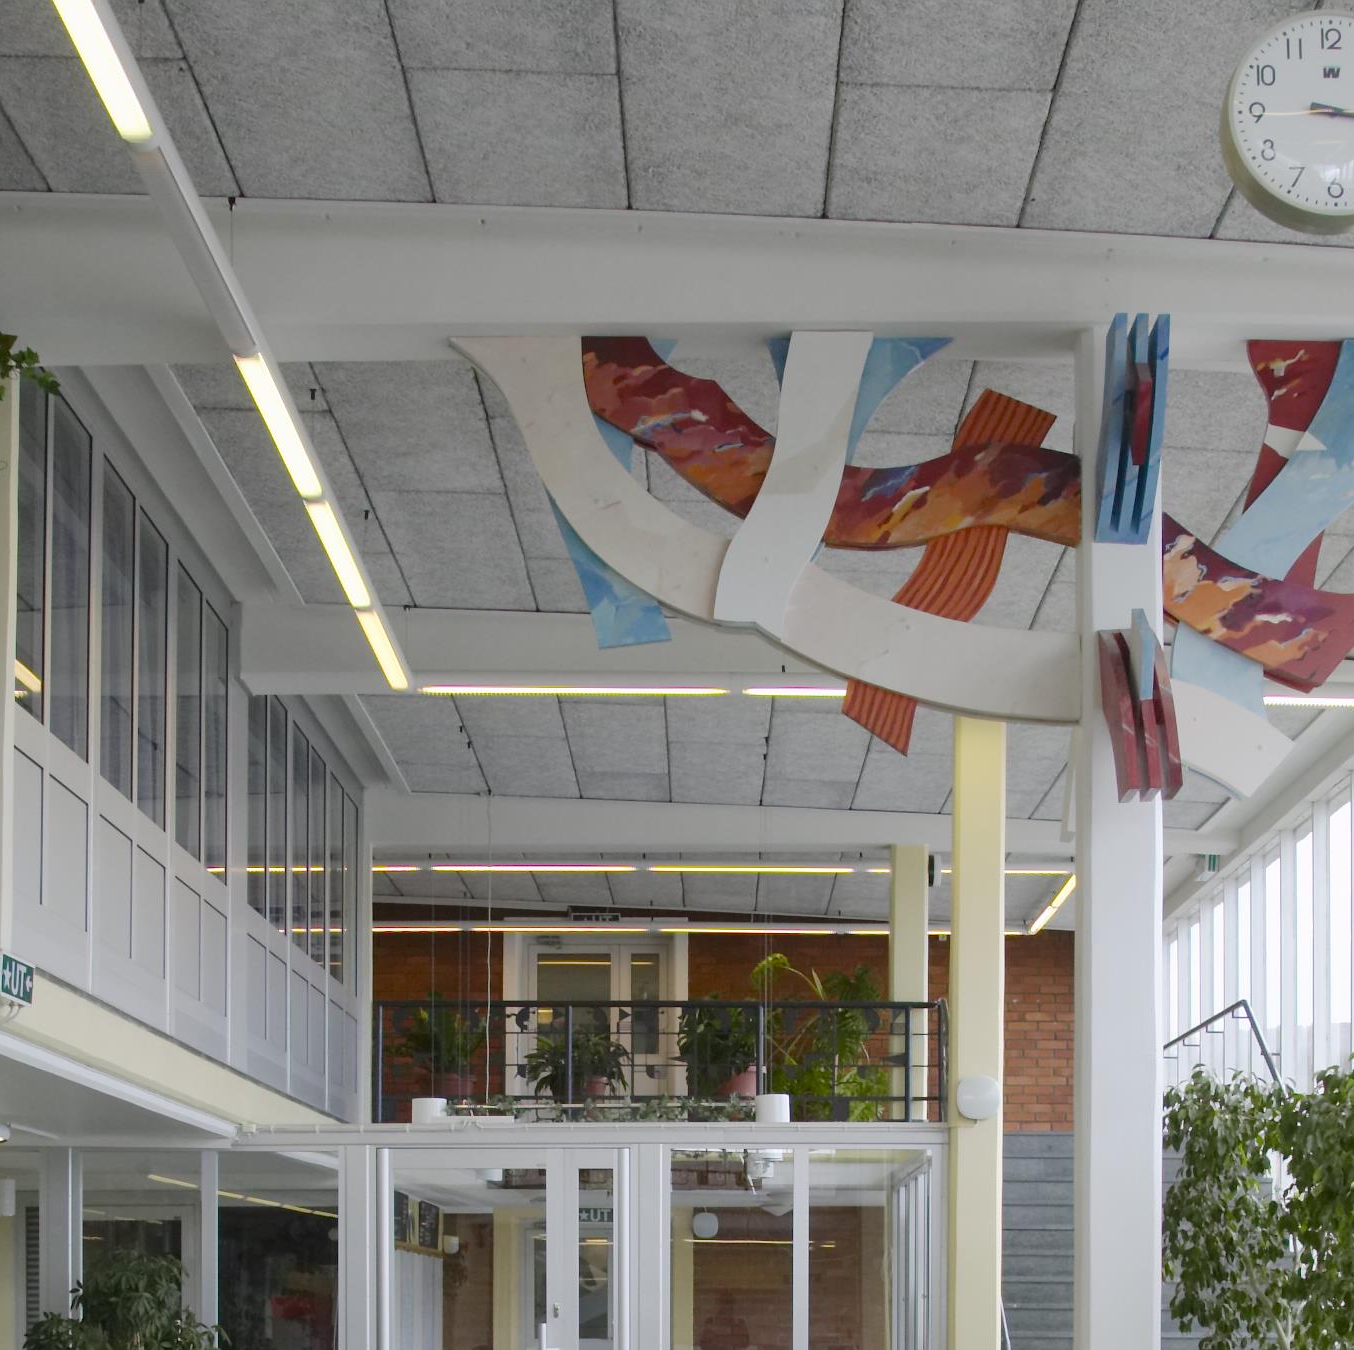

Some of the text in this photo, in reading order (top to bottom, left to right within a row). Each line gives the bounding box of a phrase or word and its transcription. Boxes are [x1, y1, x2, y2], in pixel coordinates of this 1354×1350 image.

[1286, 37, 1303, 60] 11
[1321, 27, 1342, 50] 12
[1256, 64, 1276, 86] 10
[1249, 101, 1266, 123] 9
[1261, 138, 1276, 161] 8
[1288, 166, 1306, 188] 7
[1327, 176, 1344, 199] 6
[11, 960, 27, 998] UT
[590, 1208, 612, 1222] UT
